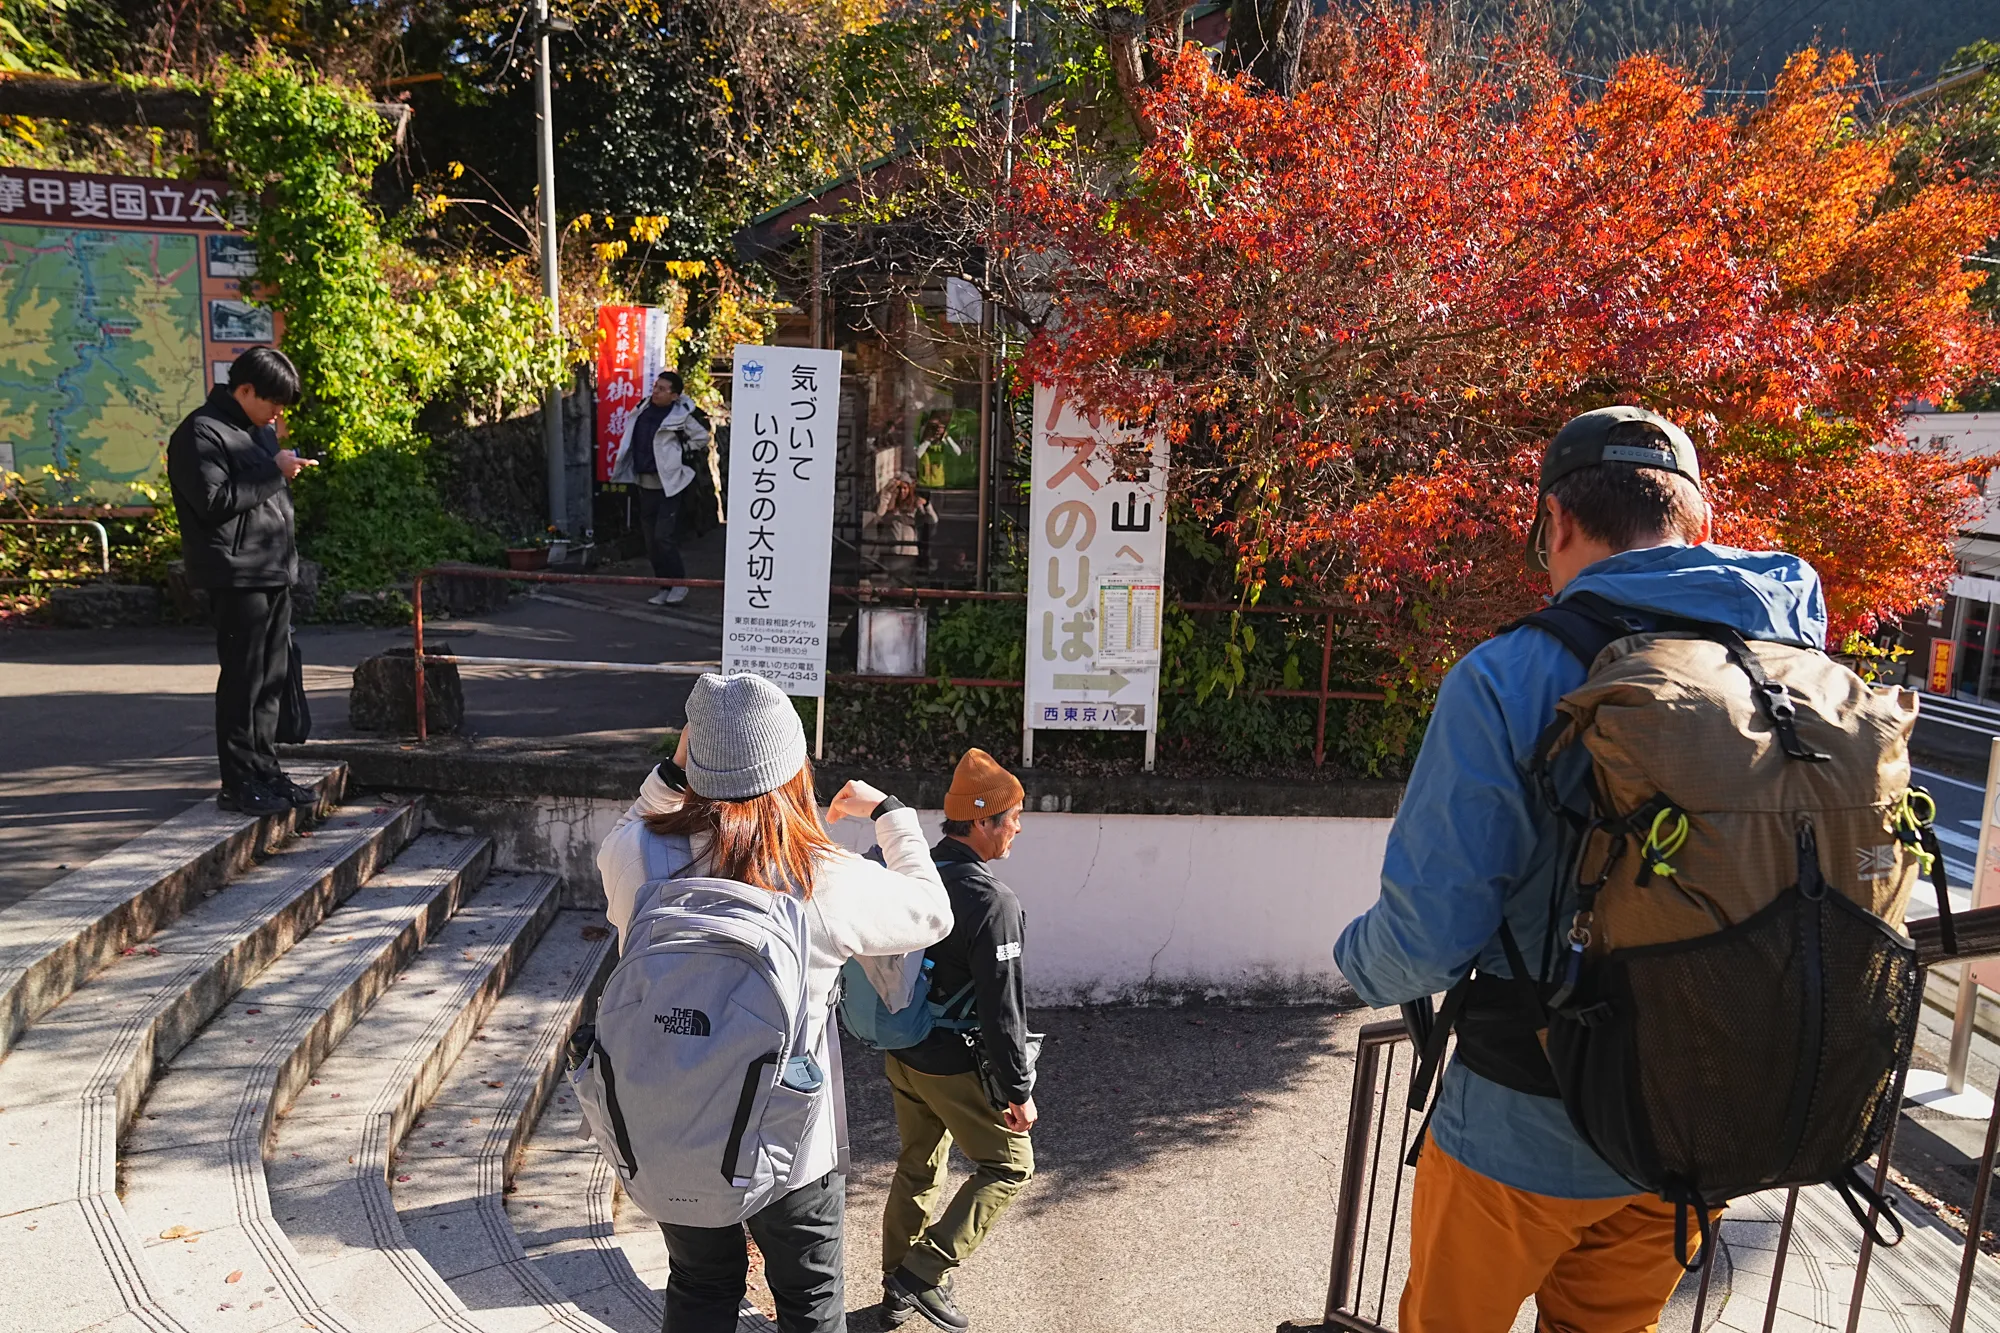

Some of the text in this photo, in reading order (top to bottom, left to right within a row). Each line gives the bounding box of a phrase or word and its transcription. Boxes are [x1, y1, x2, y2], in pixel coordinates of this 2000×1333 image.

[789, 364, 818, 481] 気づいて
[747, 412, 779, 609] いのちの大切さ
[734, 616, 817, 629] 東京都自殺相談ダイヤル
[729, 632, 820, 646] 0570-087478
[732, 659, 815, 671] 東京多摩いのちの電話
[671, 1007, 693, 1018] THE
[653, 1014, 692, 1026] NORTH
[663, 1024, 690, 1035] FACE
